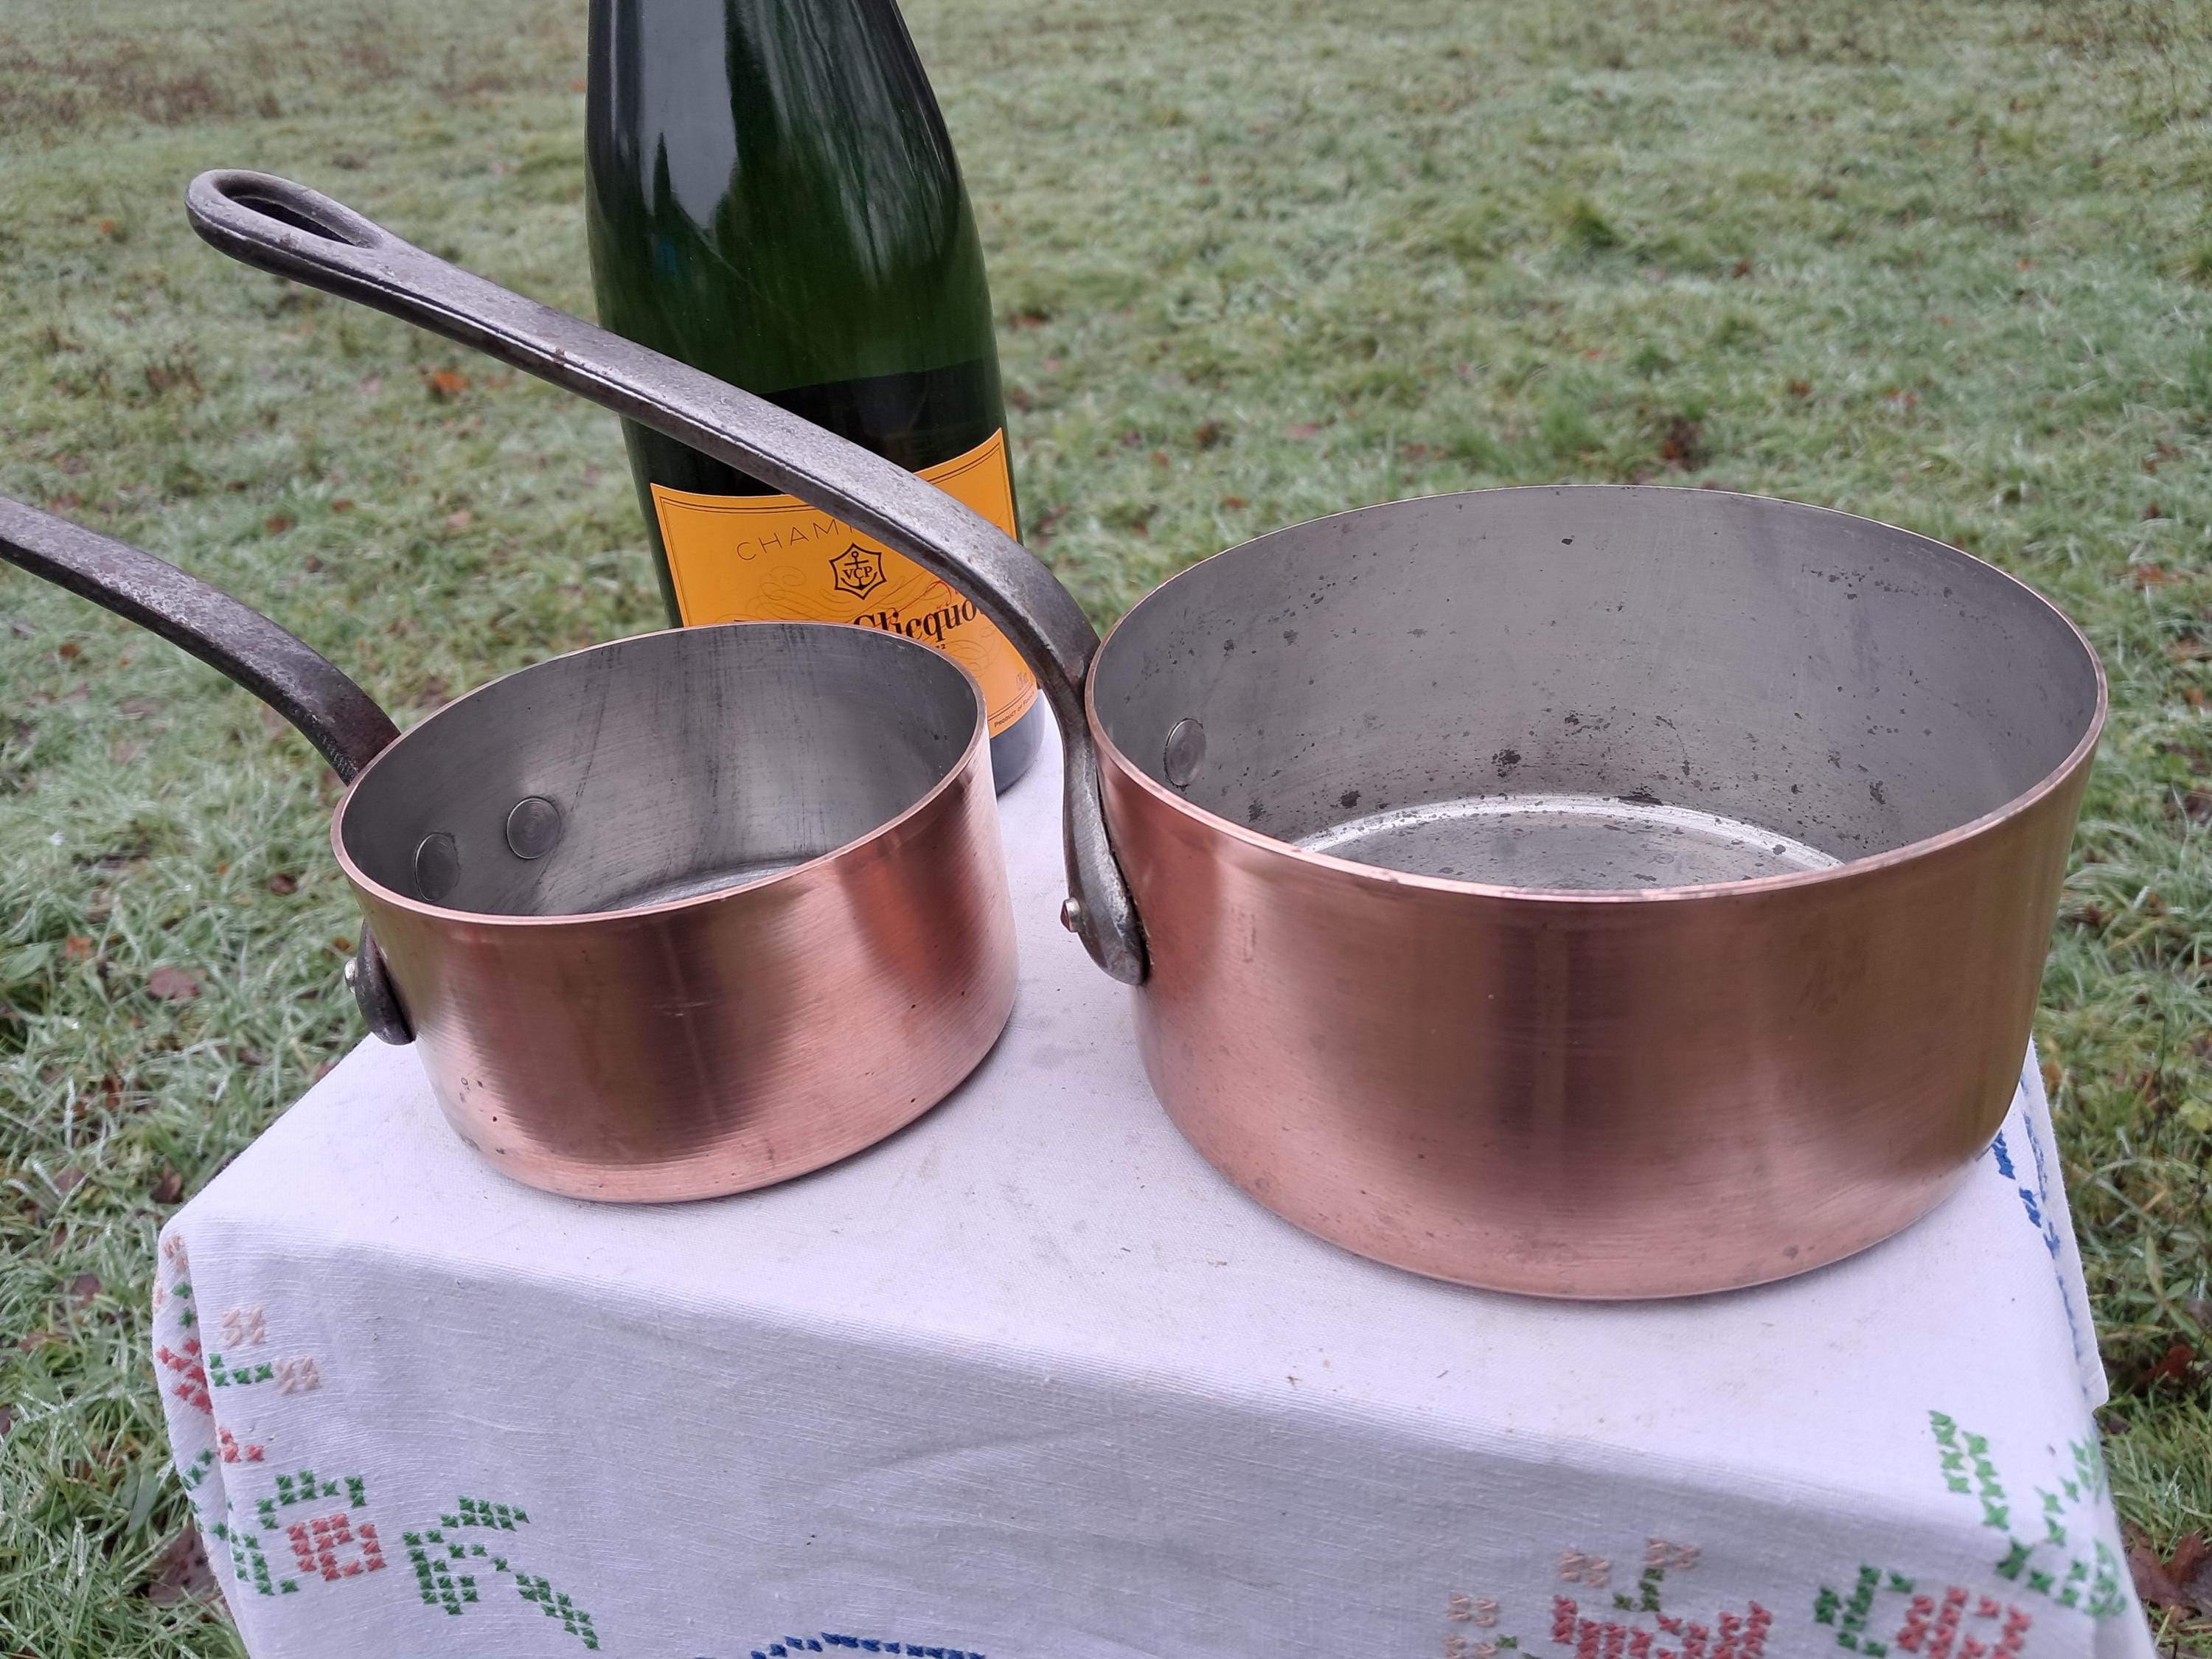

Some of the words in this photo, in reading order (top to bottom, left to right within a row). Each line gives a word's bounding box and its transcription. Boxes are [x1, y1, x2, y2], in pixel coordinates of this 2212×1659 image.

[736, 518, 855, 561] CHAM
[842, 566, 873, 580] VCP
[853, 599, 984, 643] licquo
